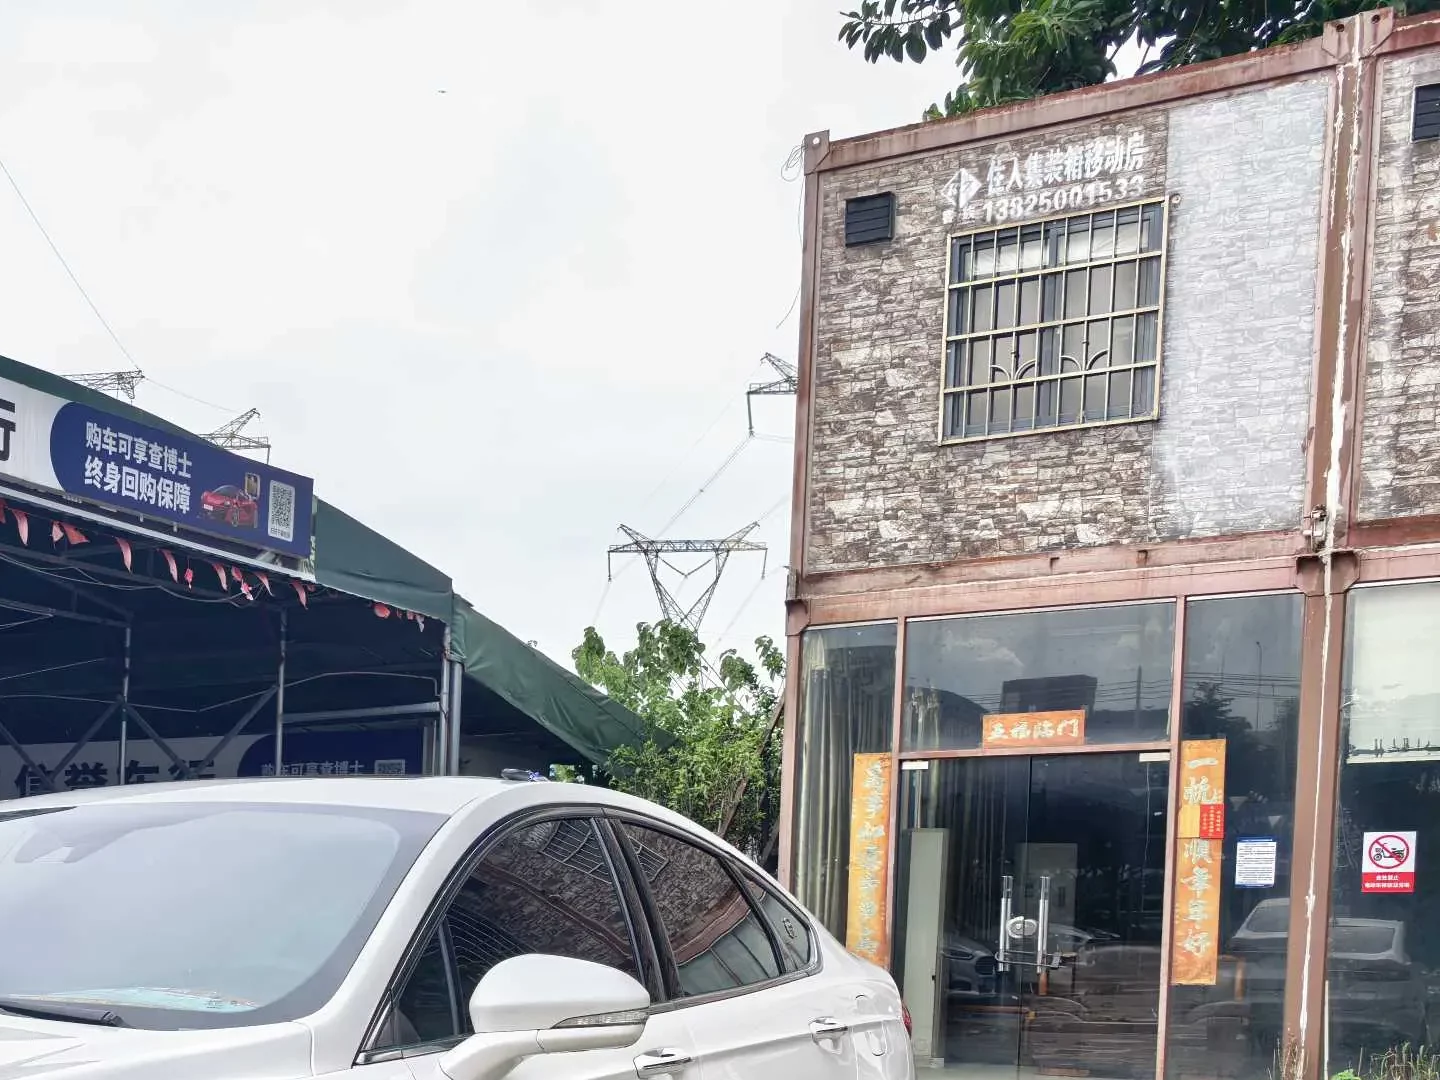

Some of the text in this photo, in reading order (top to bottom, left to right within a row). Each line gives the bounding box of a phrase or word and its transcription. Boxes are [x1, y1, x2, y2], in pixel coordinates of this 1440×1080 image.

[85, 421, 193, 479] 购车可享查博士
[84, 454, 191, 515] 终身回购保障
